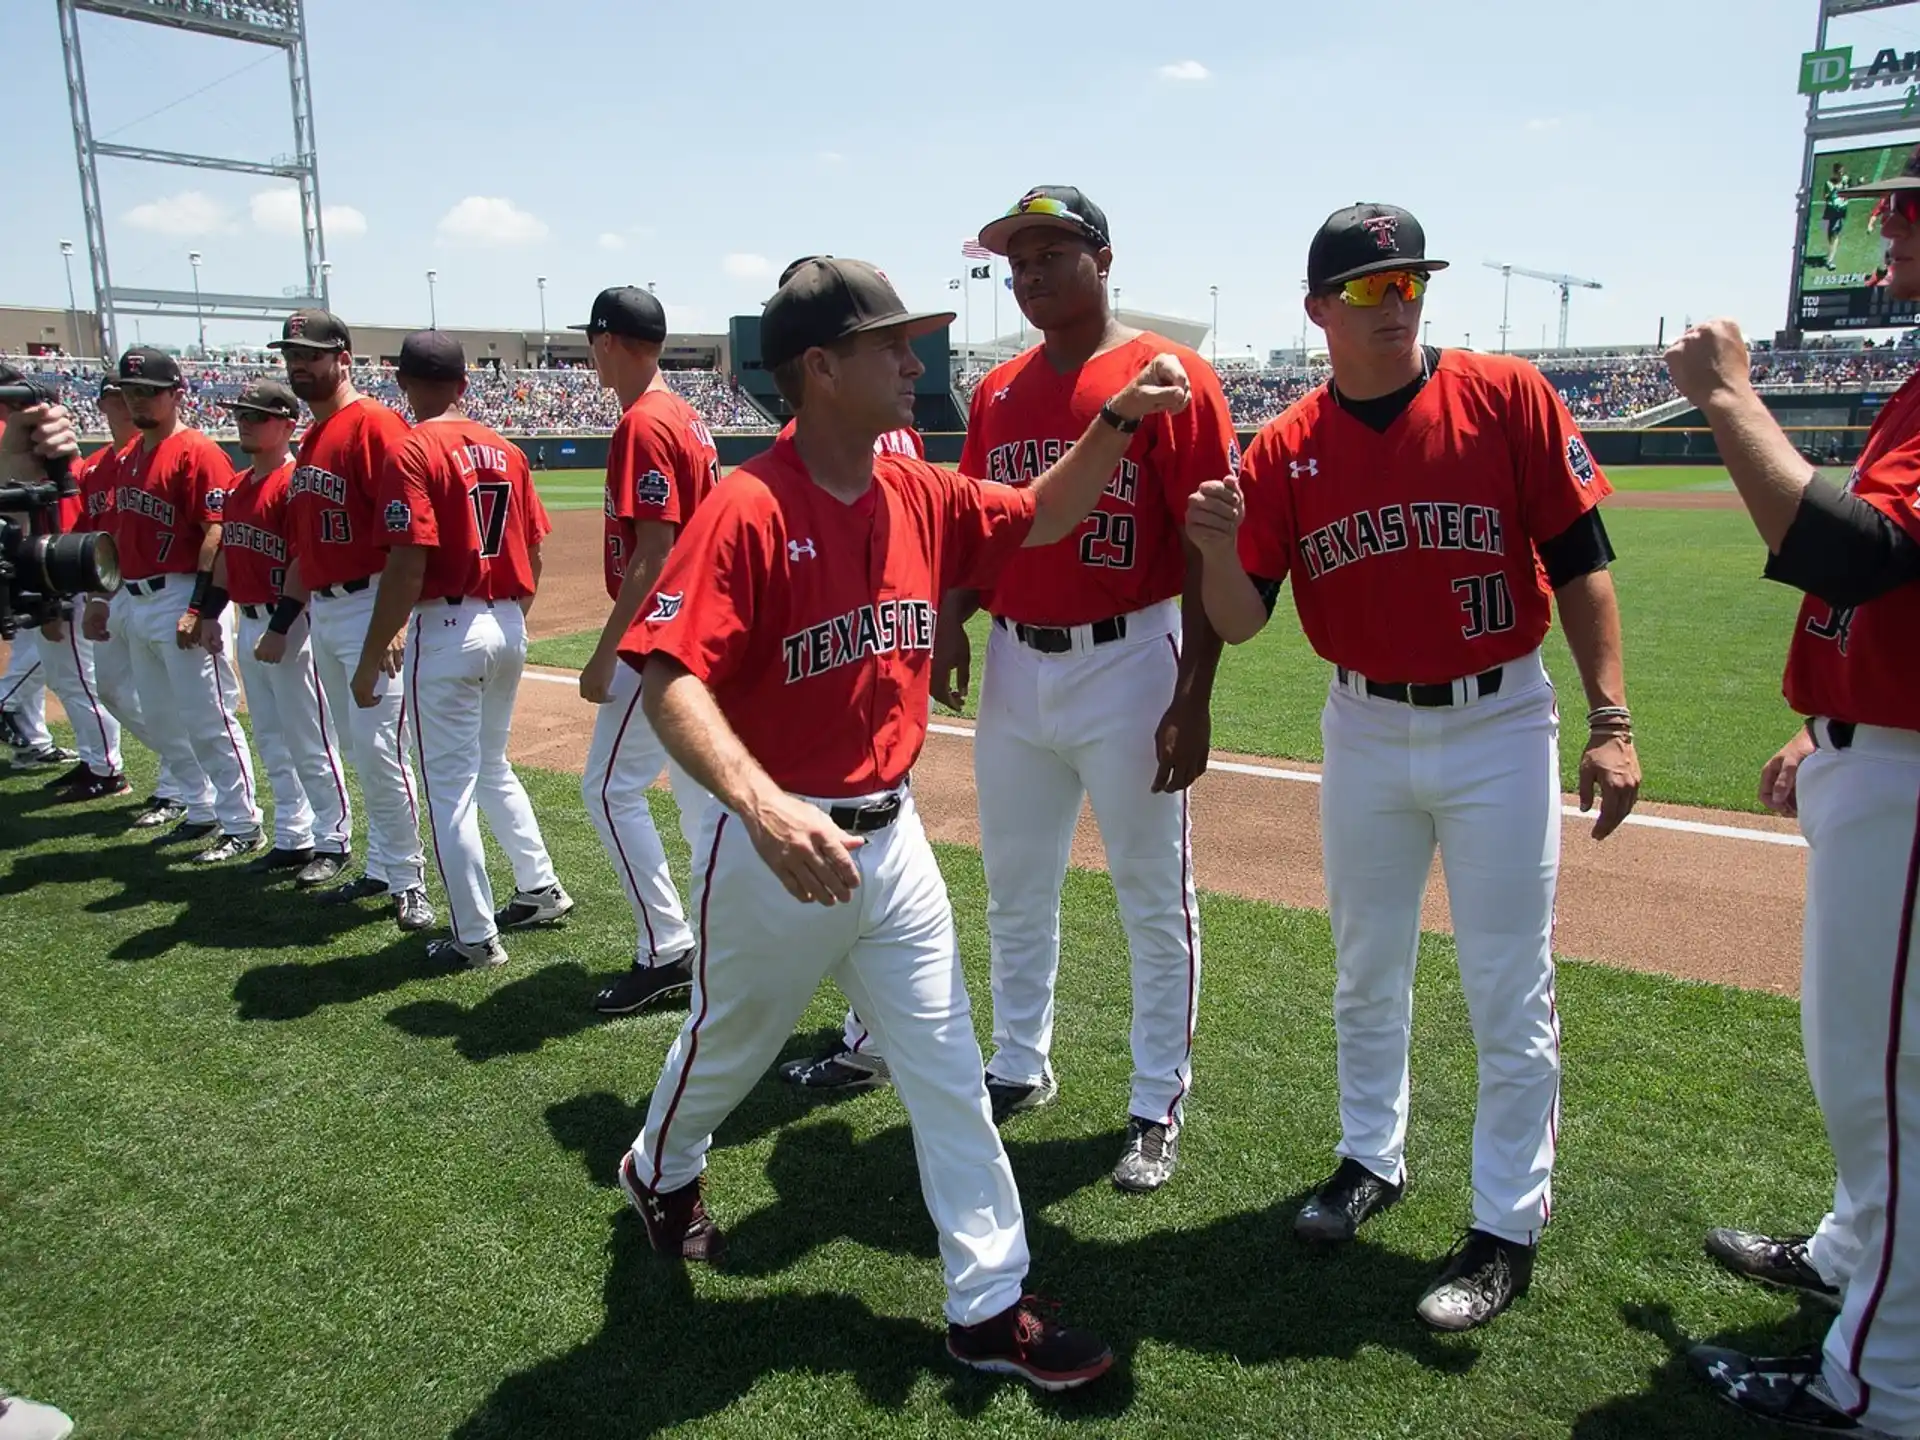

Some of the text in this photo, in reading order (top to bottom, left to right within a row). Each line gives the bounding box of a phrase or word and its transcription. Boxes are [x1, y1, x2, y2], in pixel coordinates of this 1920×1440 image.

[1806, 56, 1846, 84] TD
[1801, 307, 1819, 318] TTU
[1803, 295, 1820, 306] TCU
[320, 509, 353, 544] 13
[468, 482, 512, 558] 17
[1079, 510, 1137, 569] 29
[1300, 502, 1504, 580] TEXAS TECH
[156, 531, 175, 562] 7
[1452, 571, 1515, 640] 30
[783, 601, 896, 685] TEXAS
